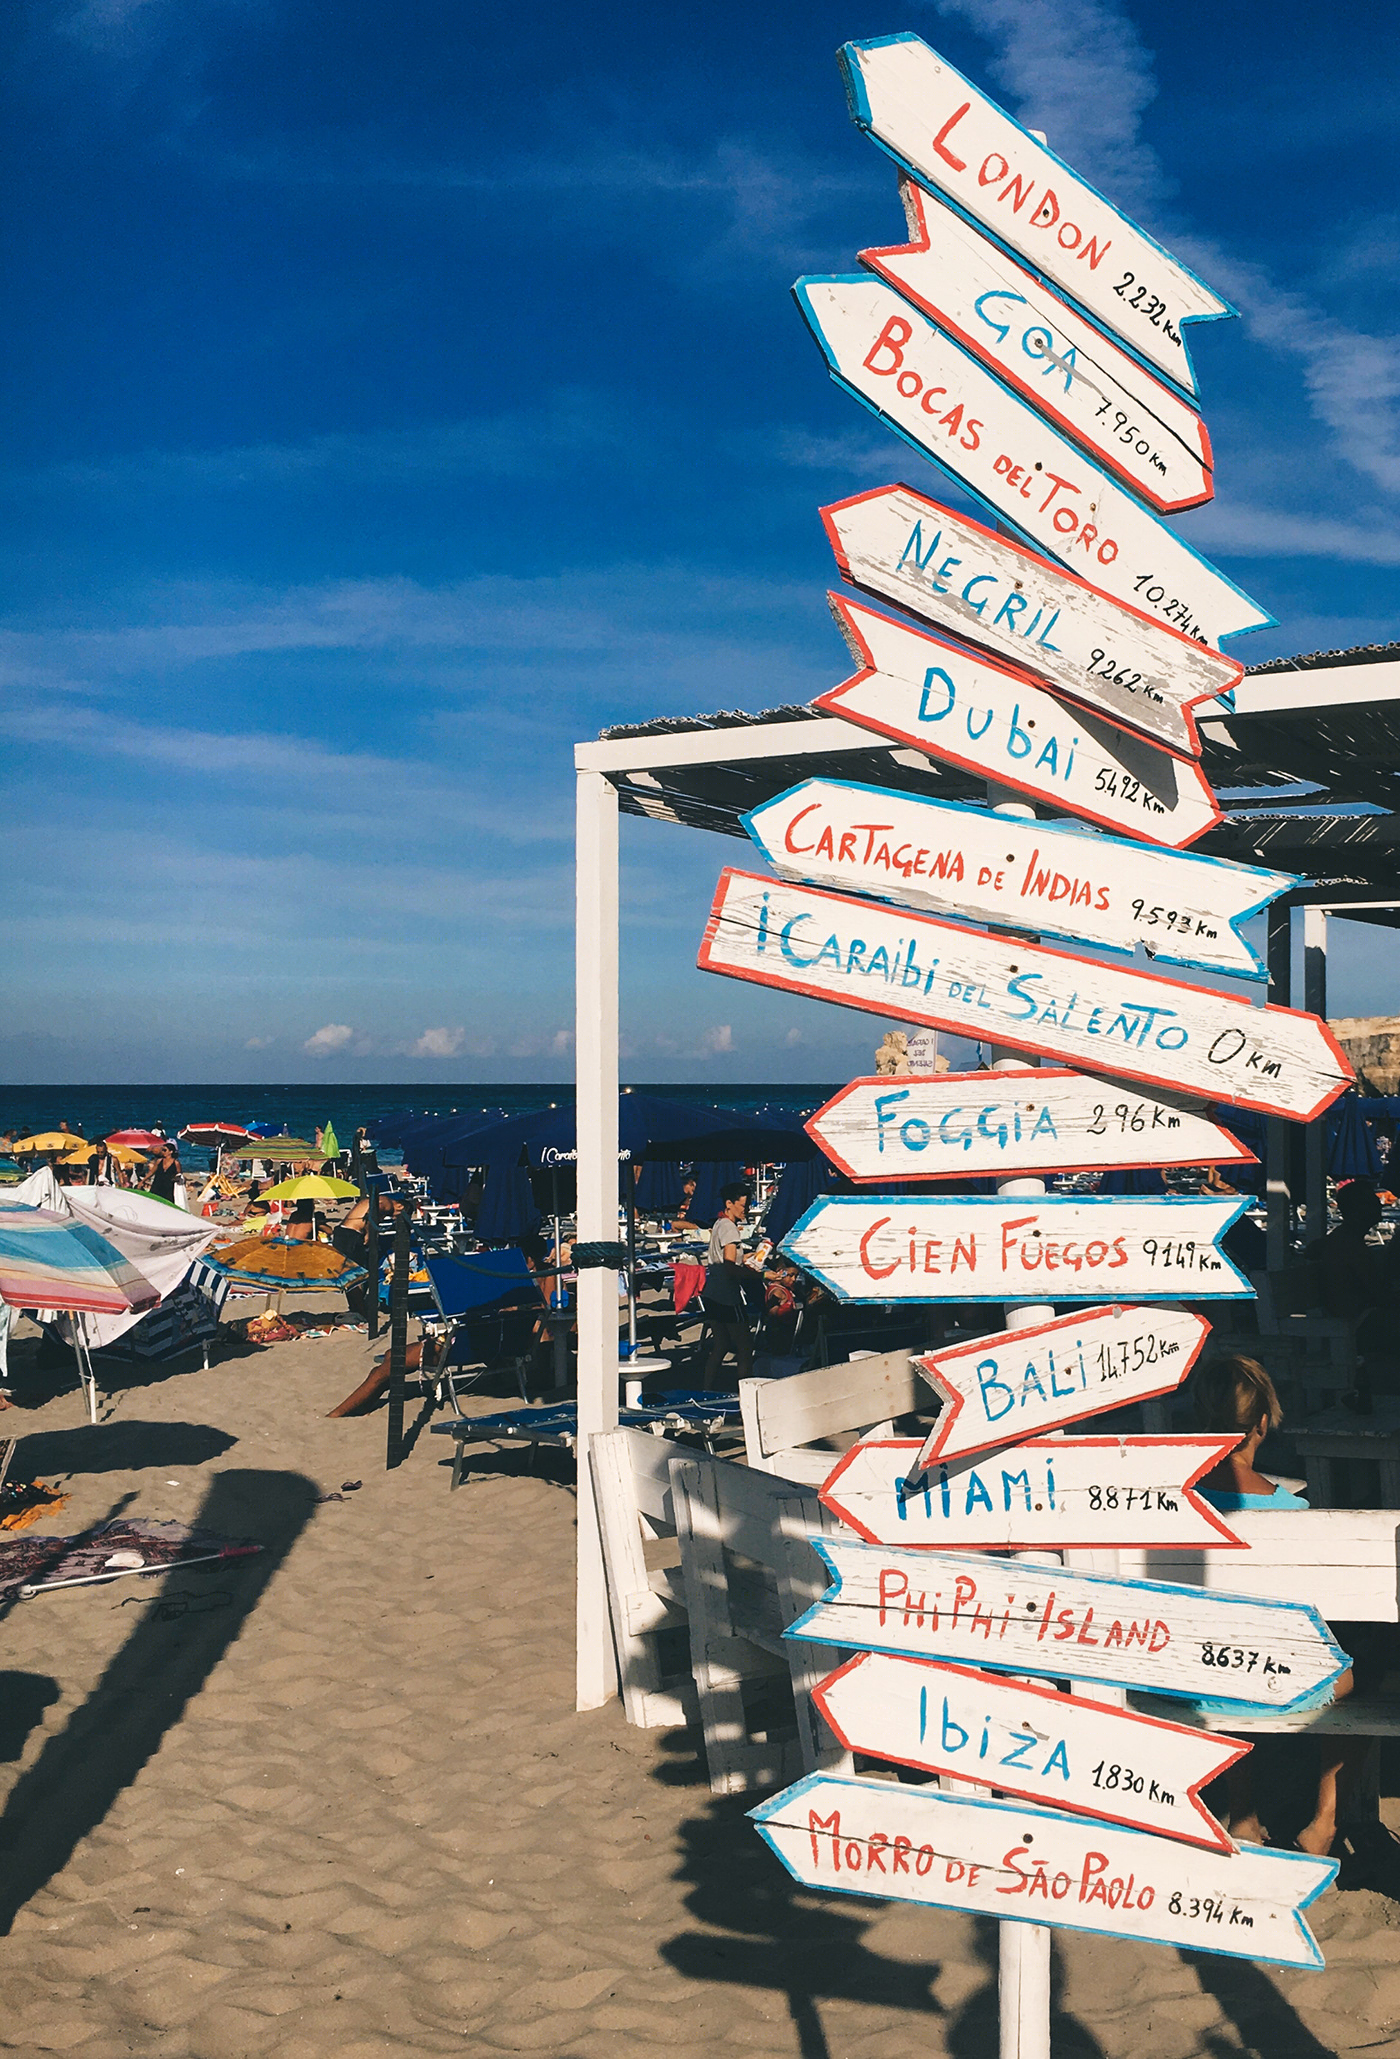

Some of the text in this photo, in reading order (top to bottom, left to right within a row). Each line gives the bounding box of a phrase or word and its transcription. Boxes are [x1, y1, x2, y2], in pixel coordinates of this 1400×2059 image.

[932, 102, 1112, 270] LONDON
[1112, 271, 1167, 326] 2.232
[974, 290, 1077, 394] GOA
[1094, 396, 1150, 456] 7.950
[862, 315, 985, 451] BOCAS
[992, 454, 1032, 499] DEL
[1036, 472, 1119, 566] TORO
[1133, 574, 1192, 634] 10.274
[896, 519, 1062, 652] NEGRIL
[1086, 648, 1142, 694] 9.262
[1094, 767, 1140, 803] 5.492
[784, 803, 966, 878] CARTAGENA
[1018, 848, 1111, 912] INDIAS
[1131, 899, 1192, 933] 9.593
[948, 979, 992, 1010] DEL
[1006, 972, 1189, 1052] SALENTO
[1207, 1028, 1247, 1064] 0
[1086, 1103, 1145, 1136] 296
[1001, 1216, 1129, 1273] FUEGOS
[1142, 1239, 1196, 1269] 9149
[1096, 1334, 1159, 1383] 14.752
[1088, 1484, 1152, 1512] 8.871
[1036, 1591, 1171, 1653] ISLAND
[1201, 1641, 1260, 1674] 8.637
[1091, 1760, 1145, 1795] 1.830
[808, 1808, 935, 1878] MORRO
[944, 1860, 981, 1888] DE
[995, 1846, 1073, 1901] SÃO
[1078, 1851, 1156, 1911] PAOLO
[1167, 1890, 1224, 1924] 8.394
